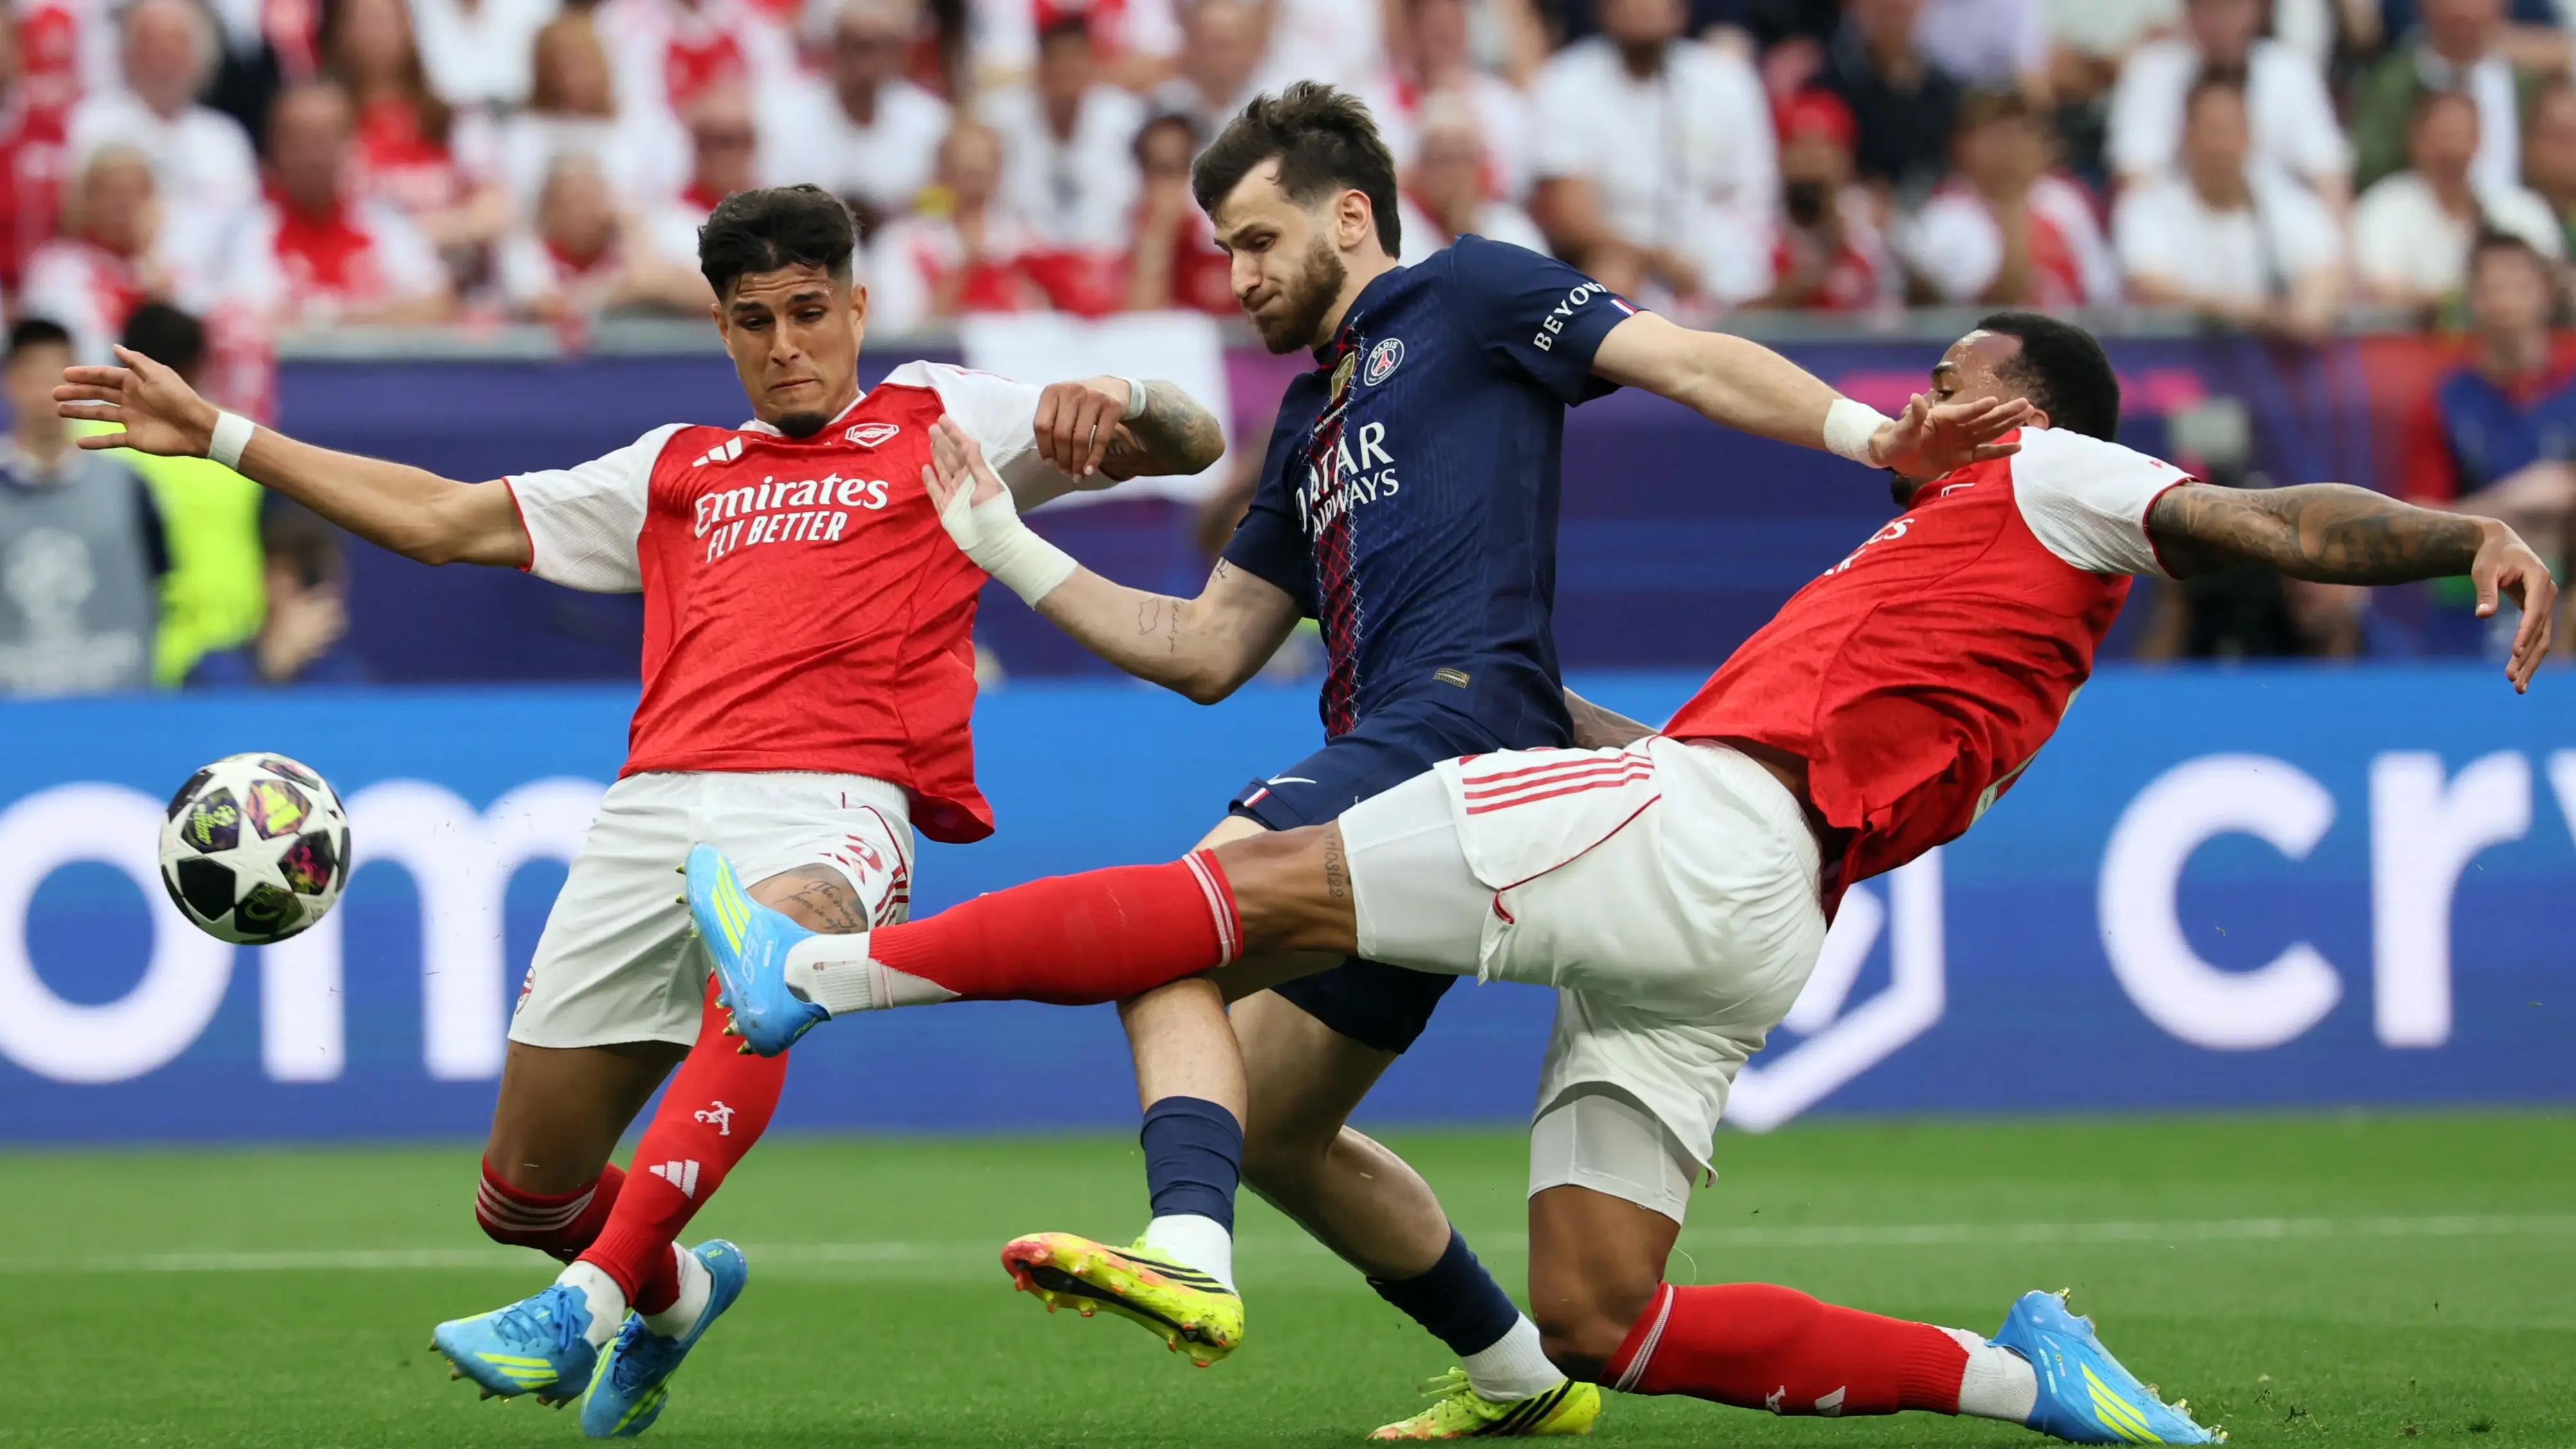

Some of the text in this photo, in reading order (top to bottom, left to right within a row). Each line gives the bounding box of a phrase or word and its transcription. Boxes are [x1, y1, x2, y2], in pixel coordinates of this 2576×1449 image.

[1371, 340, 1399, 359] PARIS
[694, 472, 889, 539] Emirates
[706, 511, 848, 564] FLY BETTER
[1312, 468, 1400, 542] AIRWAYS
[2097, 748, 2576, 1050] cr
